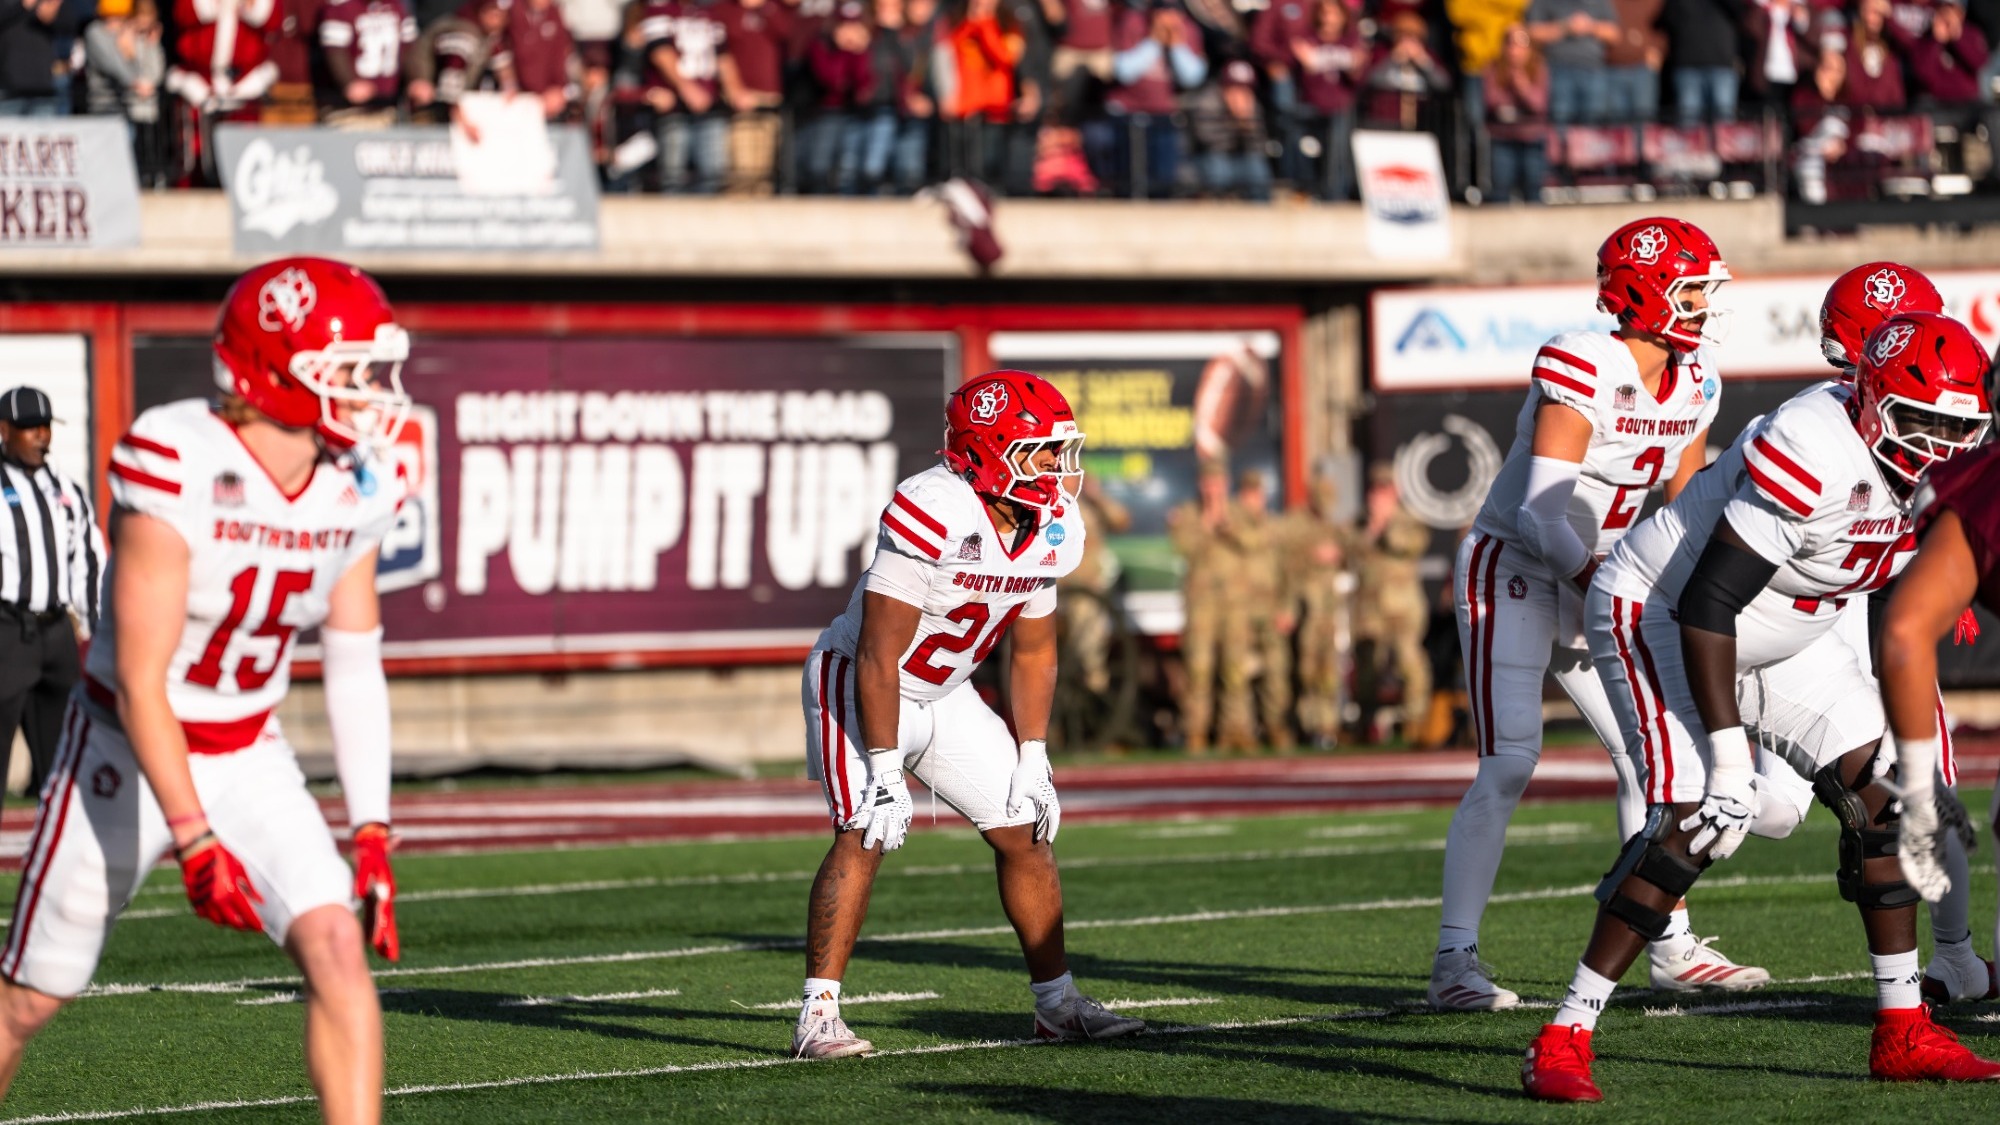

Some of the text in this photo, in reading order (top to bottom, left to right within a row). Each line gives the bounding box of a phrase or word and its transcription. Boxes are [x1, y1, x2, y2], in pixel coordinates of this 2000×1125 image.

[1688, 362, 1703, 383] C
[456, 390, 893, 441] RIGHT DOWN THE ROAD
[1615, 417, 1656, 436] SOUTH
[1601, 446, 1666, 530] 2
[213, 518, 281, 547] SOUTH
[456, 445, 685, 594] PUMP
[686, 443, 765, 590] IT
[1848, 515, 1897, 536] SOUTH
[953, 571, 1003, 593] SOUTH
[184, 565, 316, 692] 15
